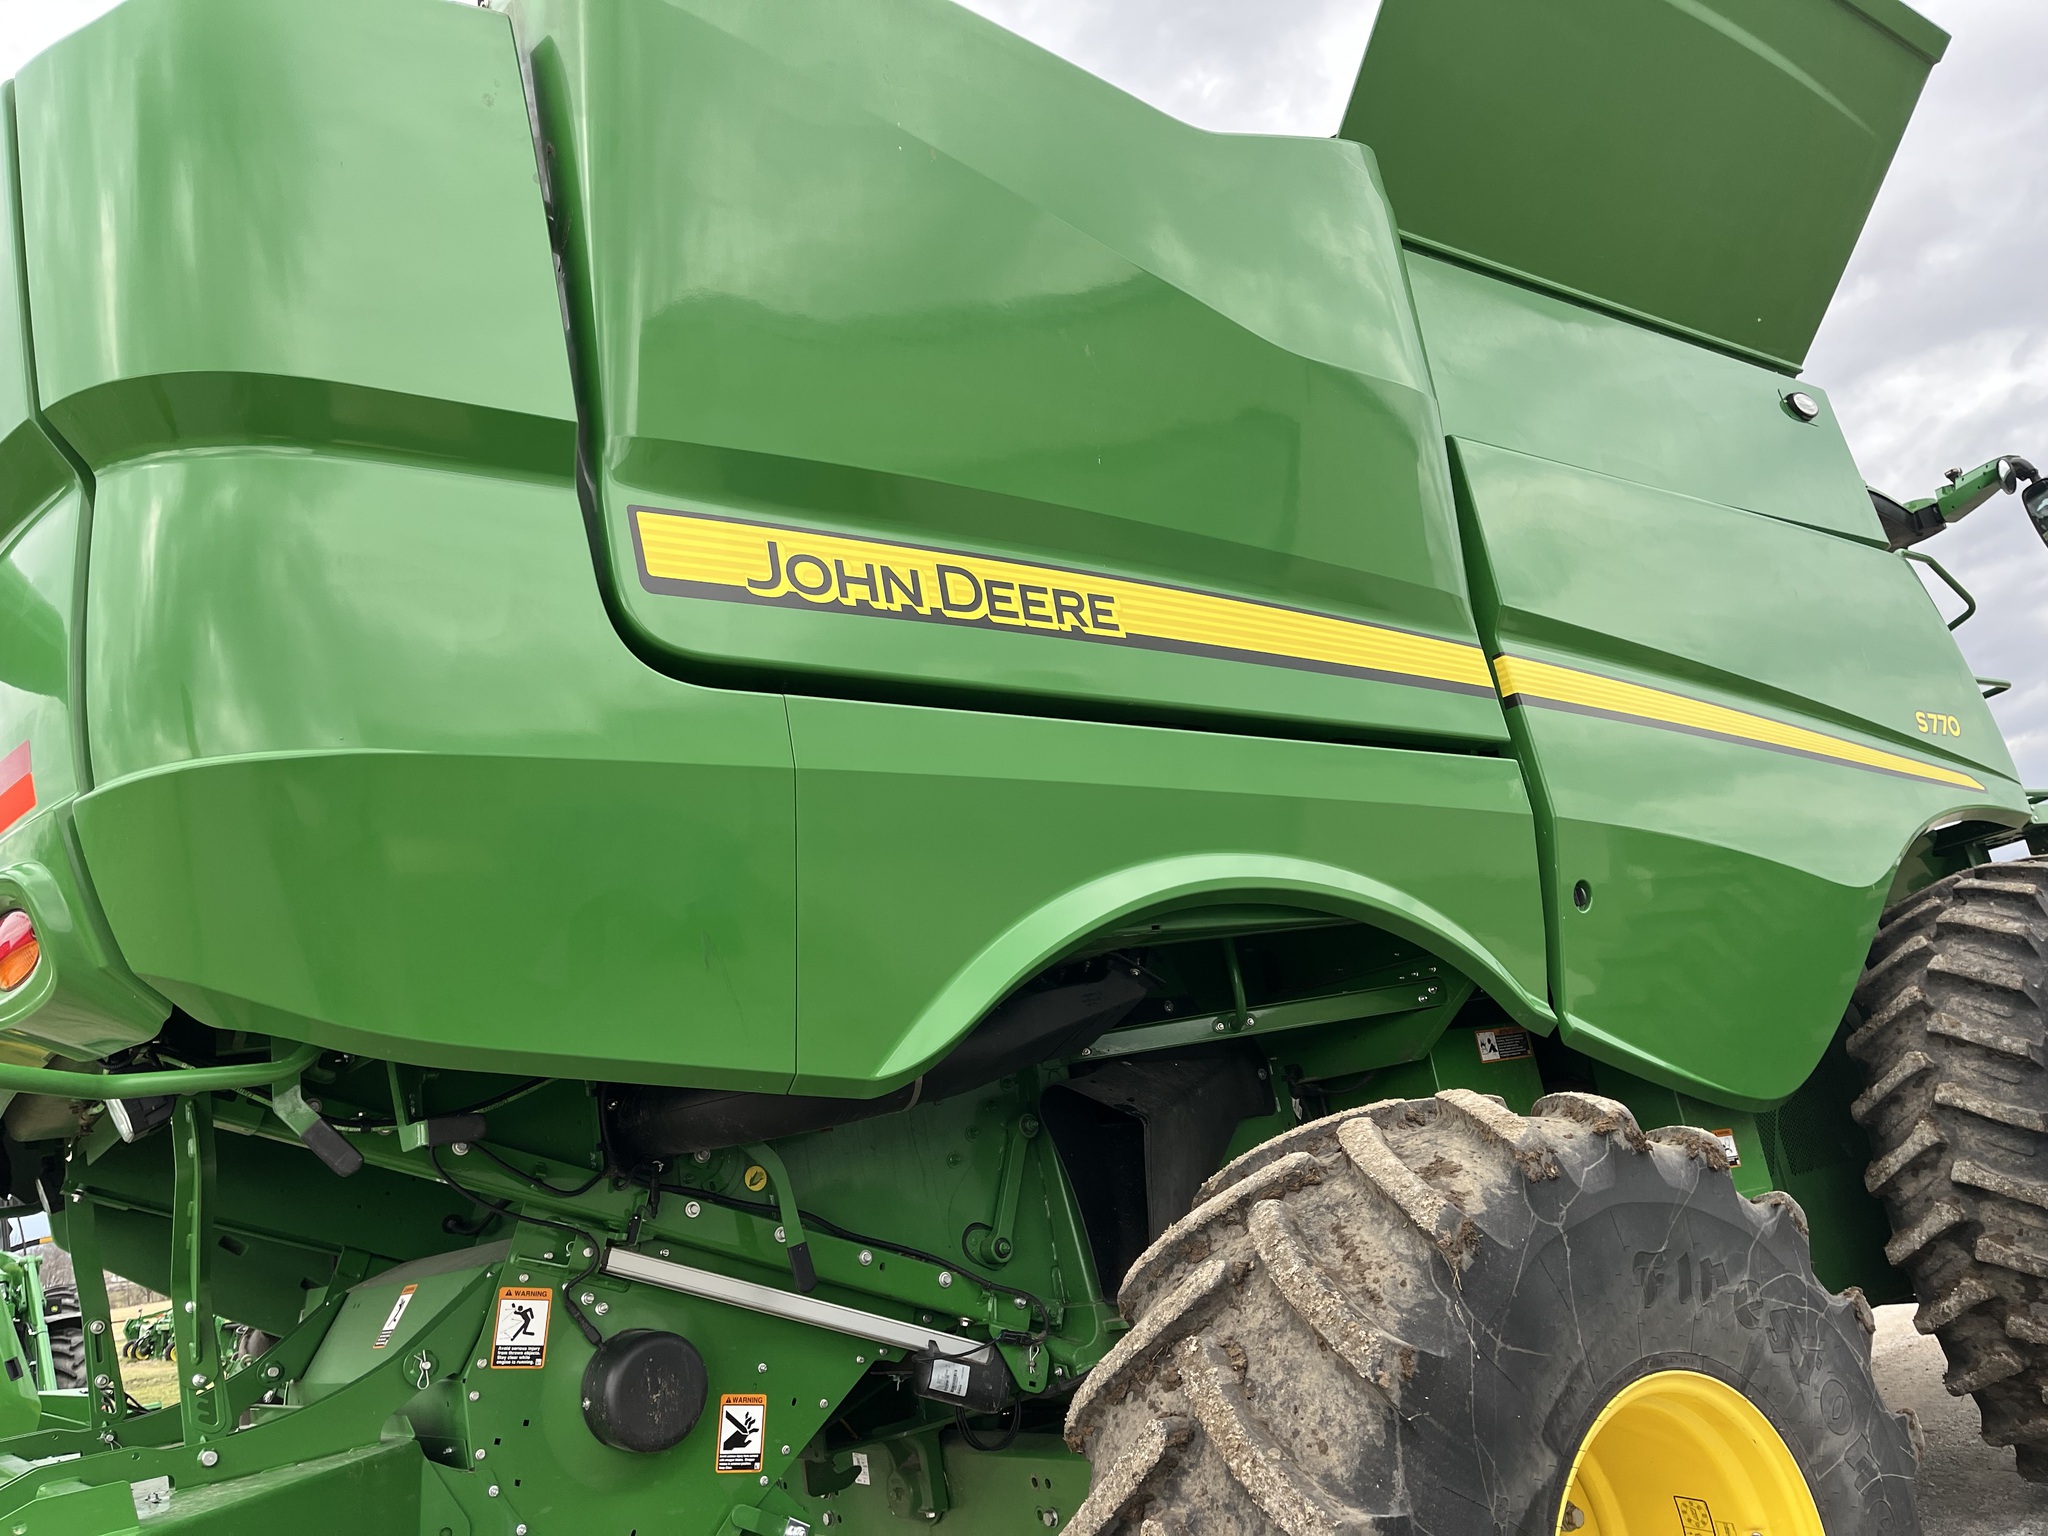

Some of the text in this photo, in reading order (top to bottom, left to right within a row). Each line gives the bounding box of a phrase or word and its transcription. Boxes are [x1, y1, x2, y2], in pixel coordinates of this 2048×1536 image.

[746, 540, 1123, 632] JOHN DEERE
[1915, 710, 1961, 737] S770
[732, 1396, 763, 1404] WARNING
